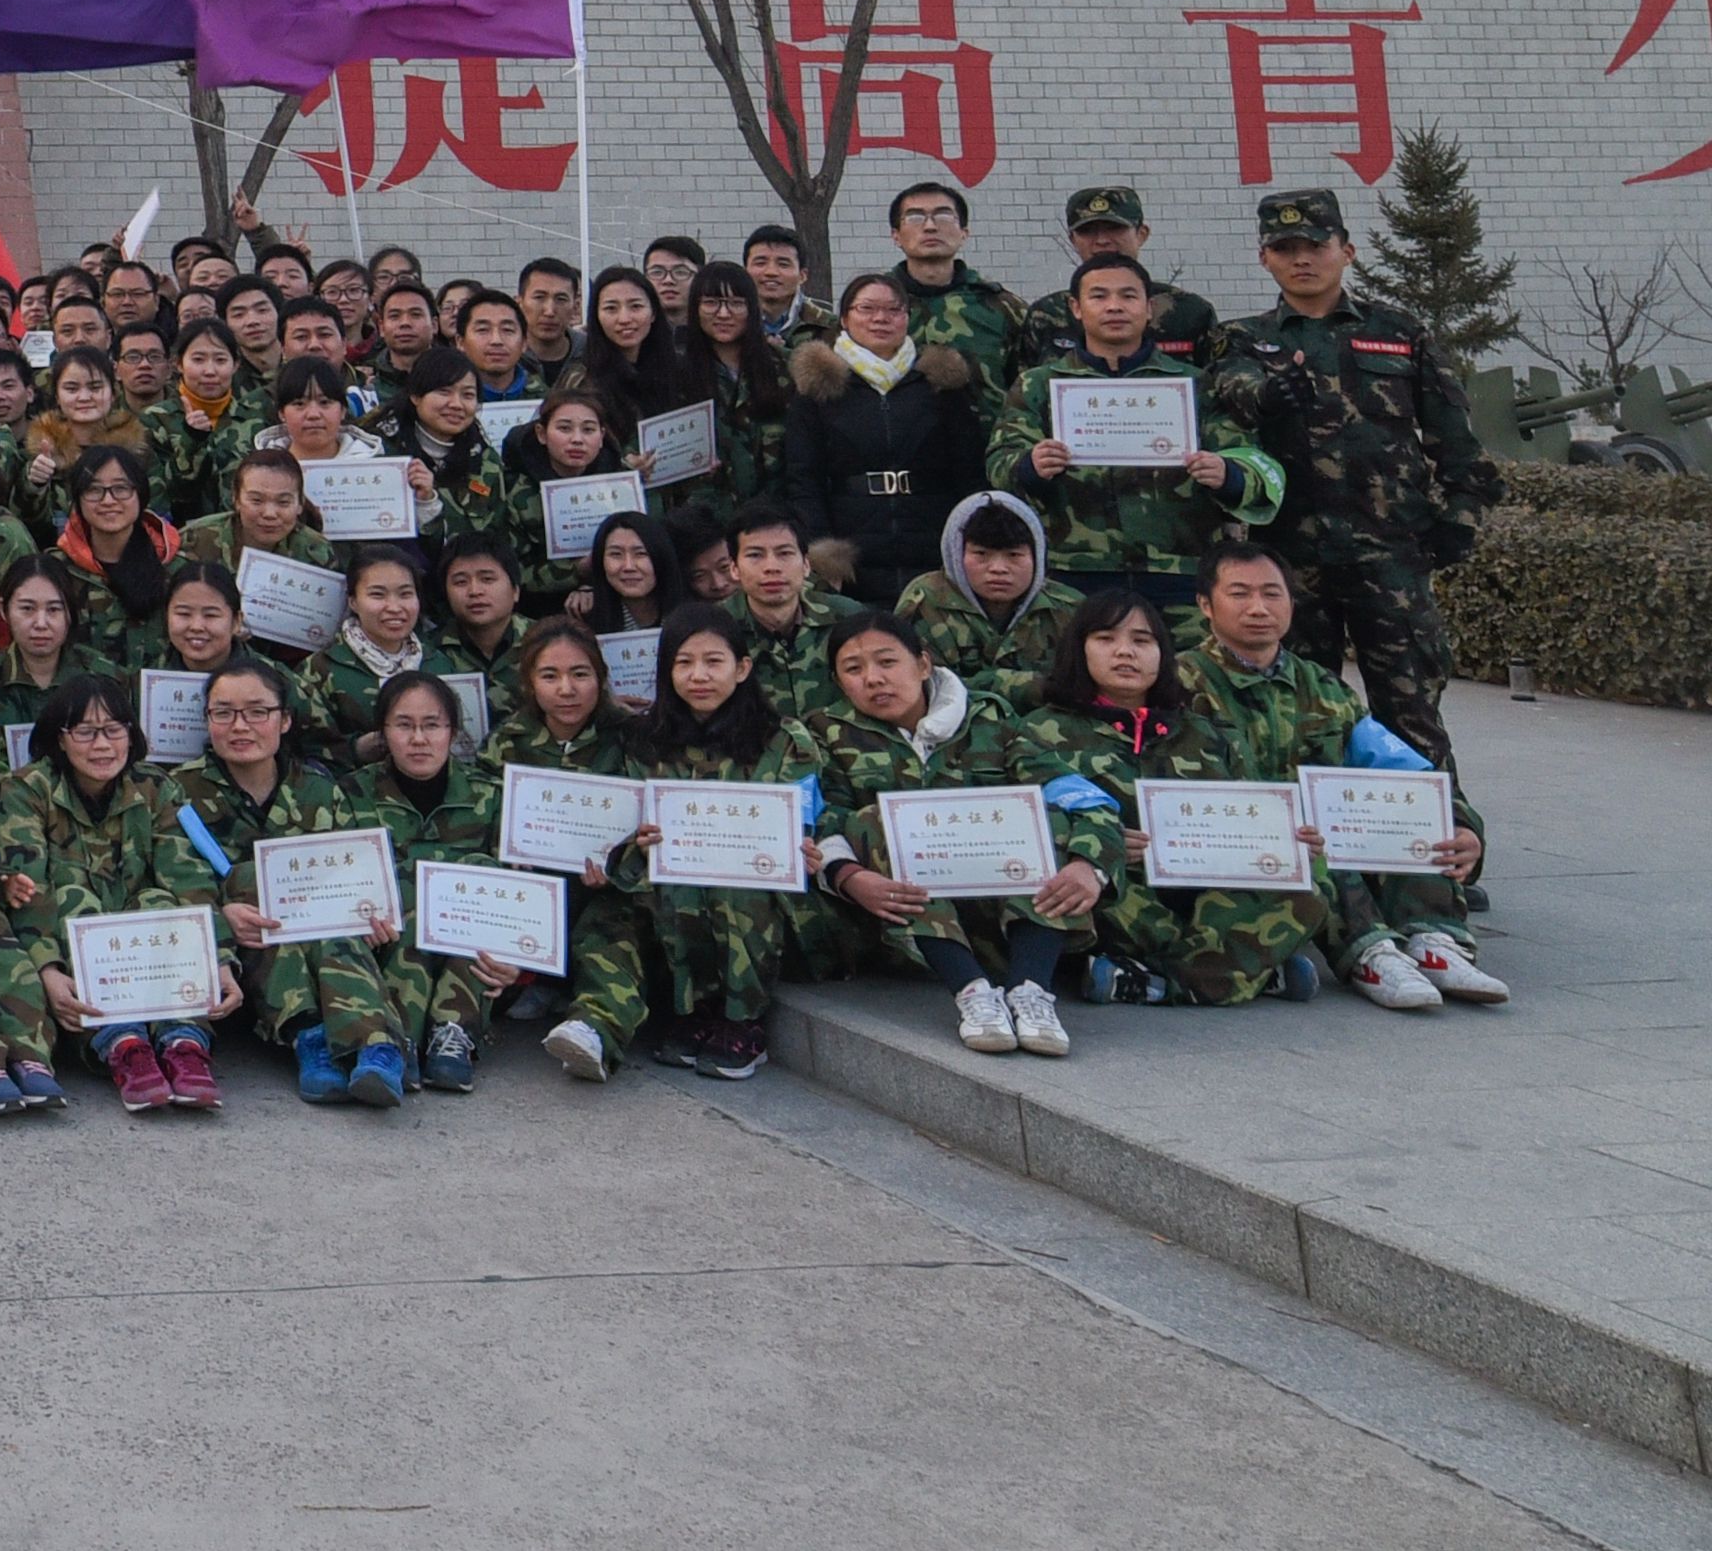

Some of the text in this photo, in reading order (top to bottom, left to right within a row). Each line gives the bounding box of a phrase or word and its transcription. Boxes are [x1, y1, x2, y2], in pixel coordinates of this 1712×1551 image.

[1087, 396, 1157, 409] 结业证书
[324, 475, 382, 487] 结业证书
[270, 571, 327, 597] 结业证书
[541, 790, 613, 811] 结业证书
[1342, 788, 1415, 805] 结业证书
[685, 801, 760, 819] 结业证书
[924, 809, 1004, 827] 结业证书
[1179, 802, 1259, 819] 结业证书
[288, 852, 354, 872] 结业证书
[454, 882, 526, 903] 结业证书
[108, 931, 179, 951] 结业证书
